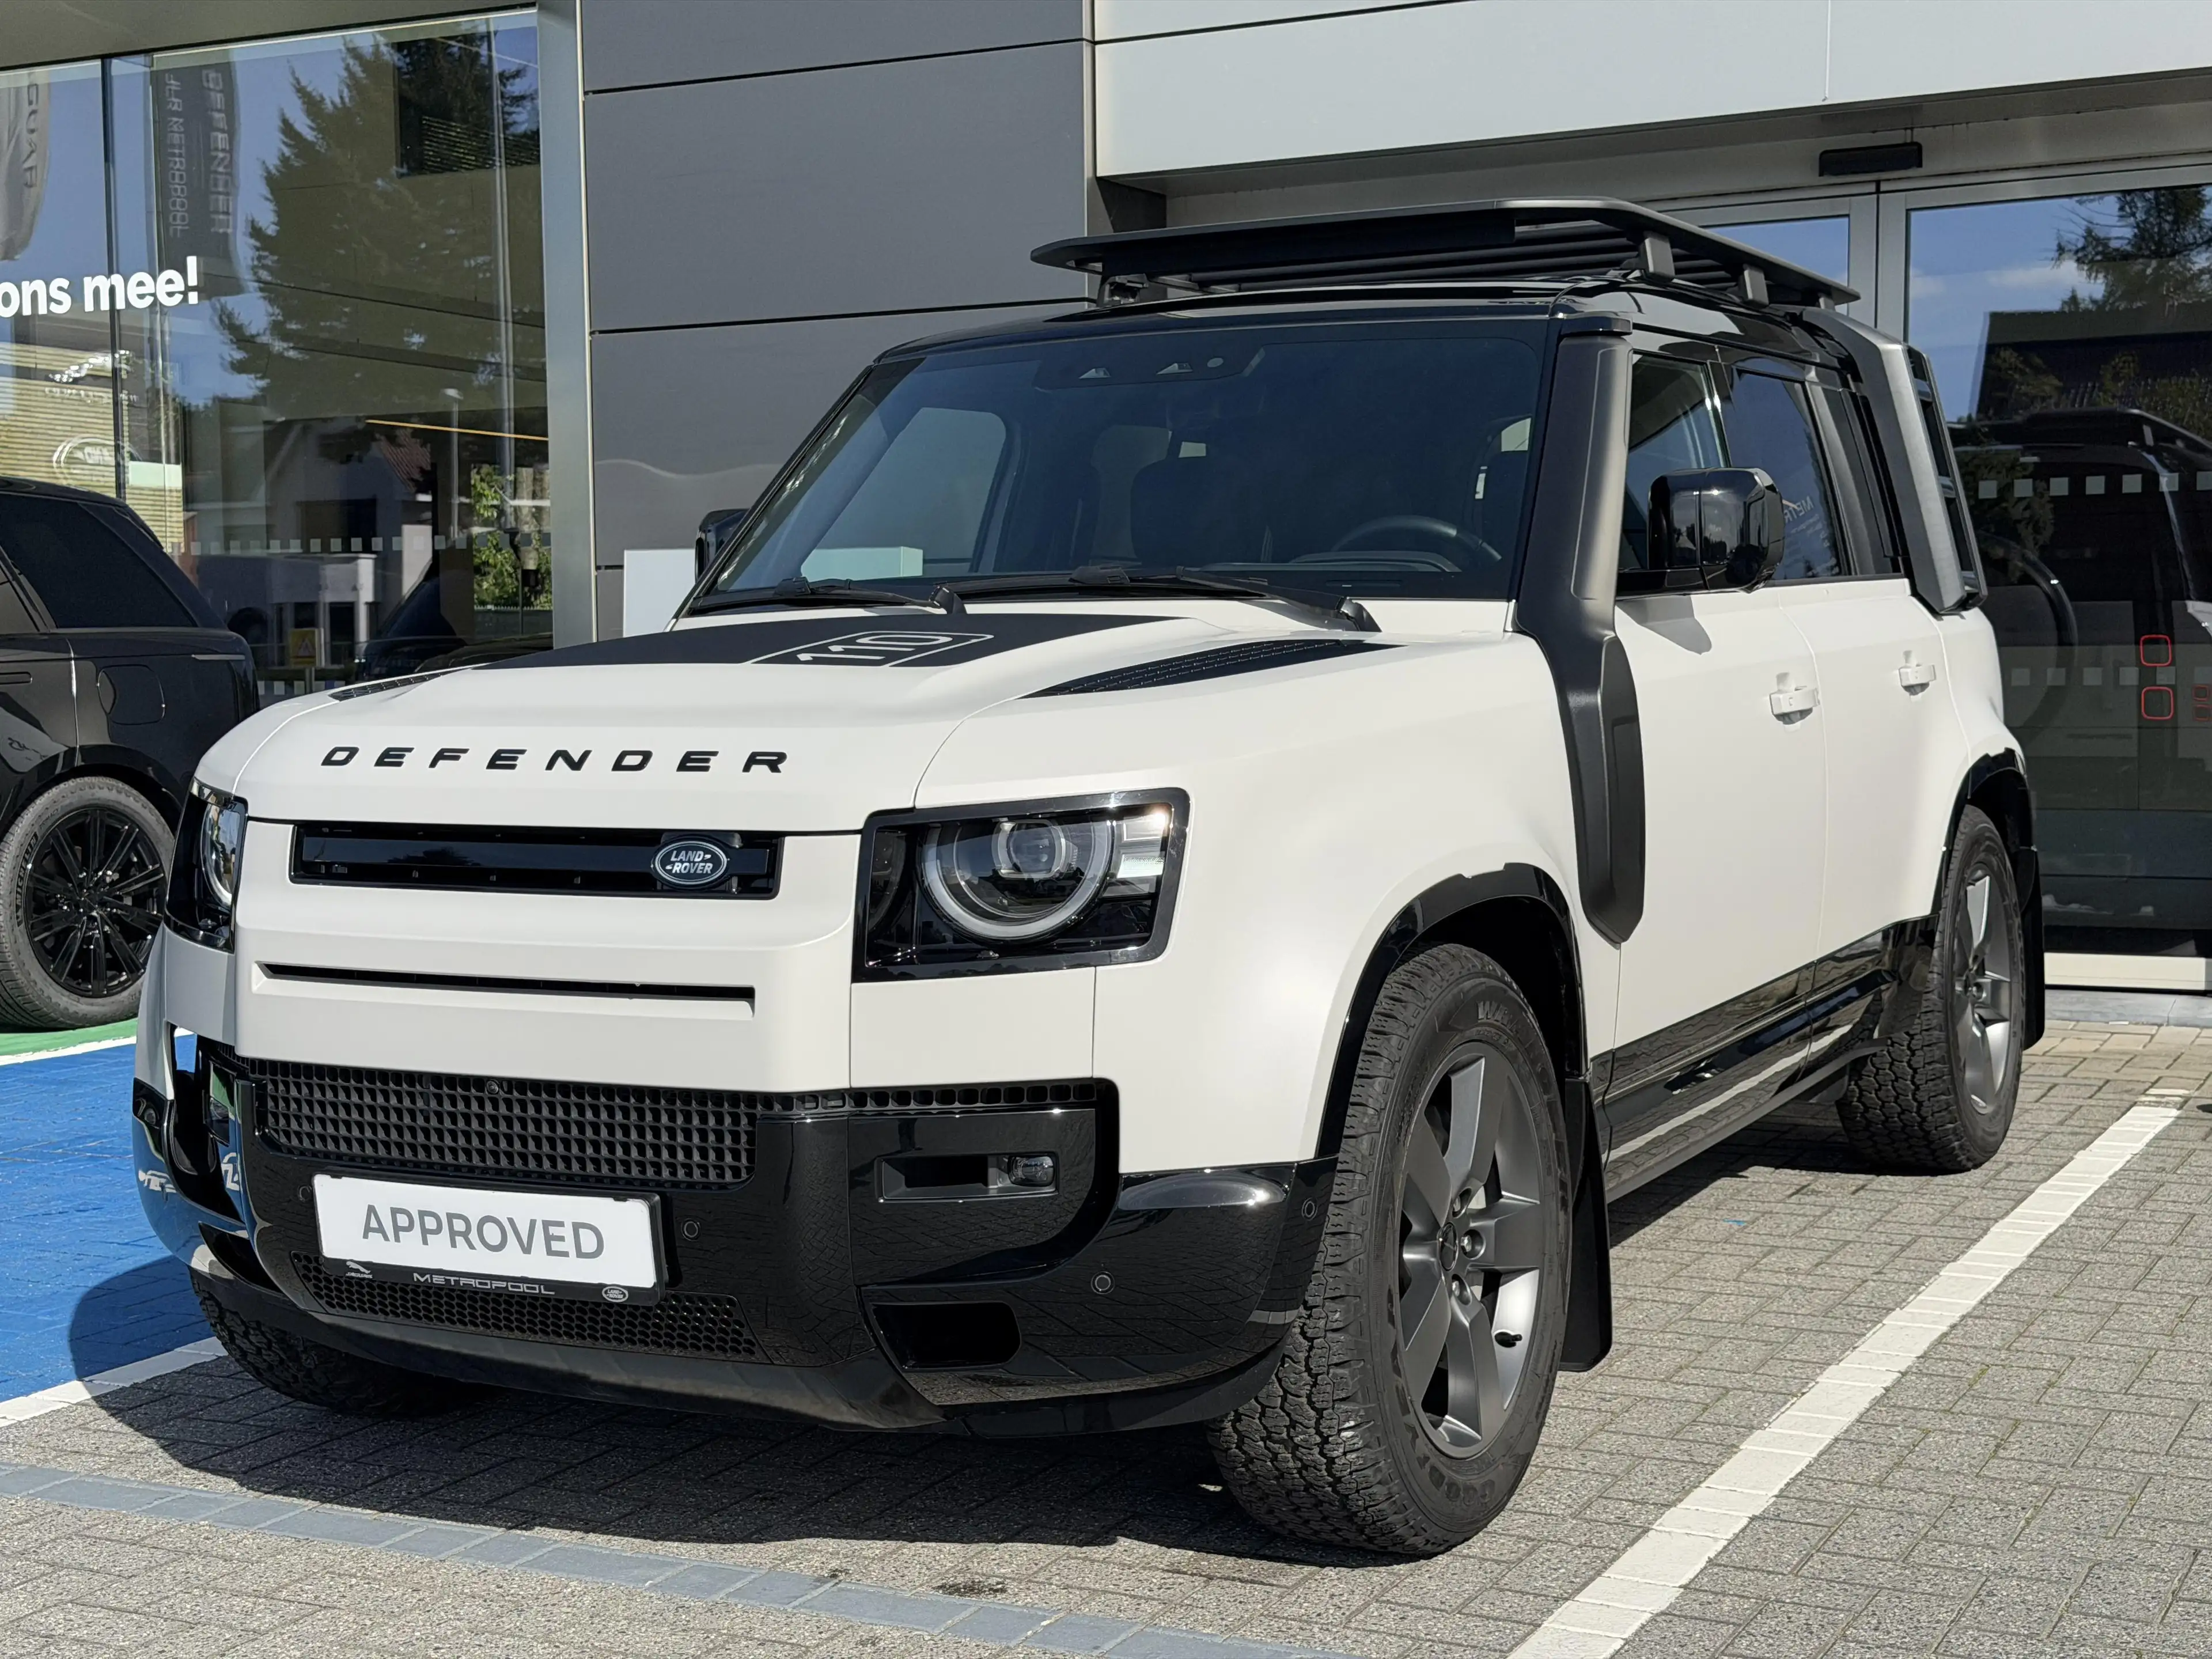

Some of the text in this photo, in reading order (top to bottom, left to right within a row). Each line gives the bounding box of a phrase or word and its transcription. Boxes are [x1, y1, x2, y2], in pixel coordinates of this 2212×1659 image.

[202, 69, 233, 234] DEFENDER
[0, 255, 199, 318] ons mee!
[797, 634, 953, 661] 110
[321, 746, 787, 774] DEFENDER
[671, 850, 704, 862] LAND
[672, 862, 713, 874] ROVER
[362, 1204, 605, 1260] APPROVED
[413, 1272, 555, 1296] METROPOOL
